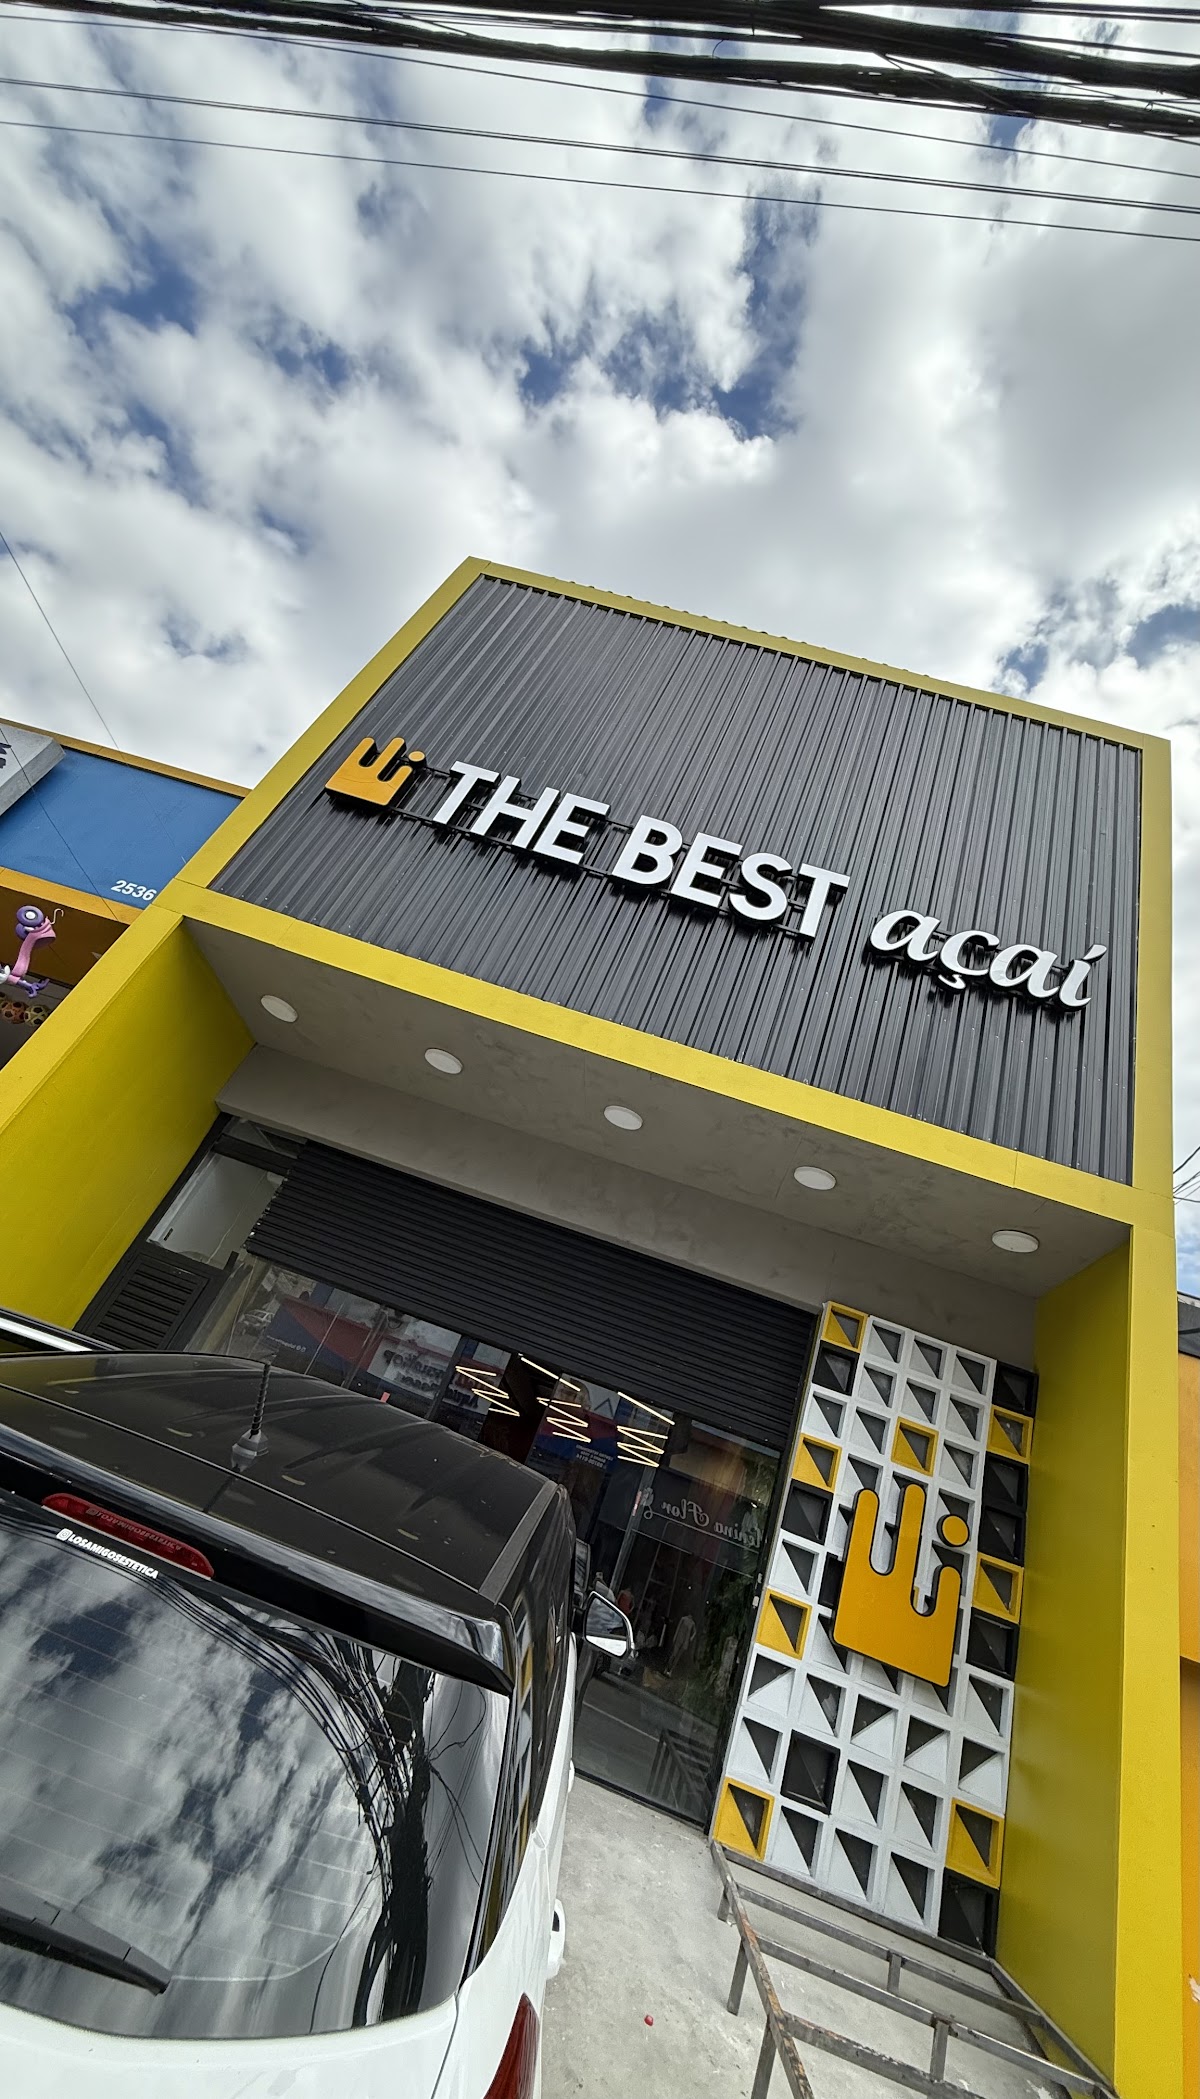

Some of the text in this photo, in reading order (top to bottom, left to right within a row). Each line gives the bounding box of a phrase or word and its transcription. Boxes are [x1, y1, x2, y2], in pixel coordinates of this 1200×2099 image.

[110, 879, 157, 902] 2536
[432, 760, 1108, 1009] THE BEST açaí
[67, 1533, 159, 1580] LOSAMIGOSESTETICA
